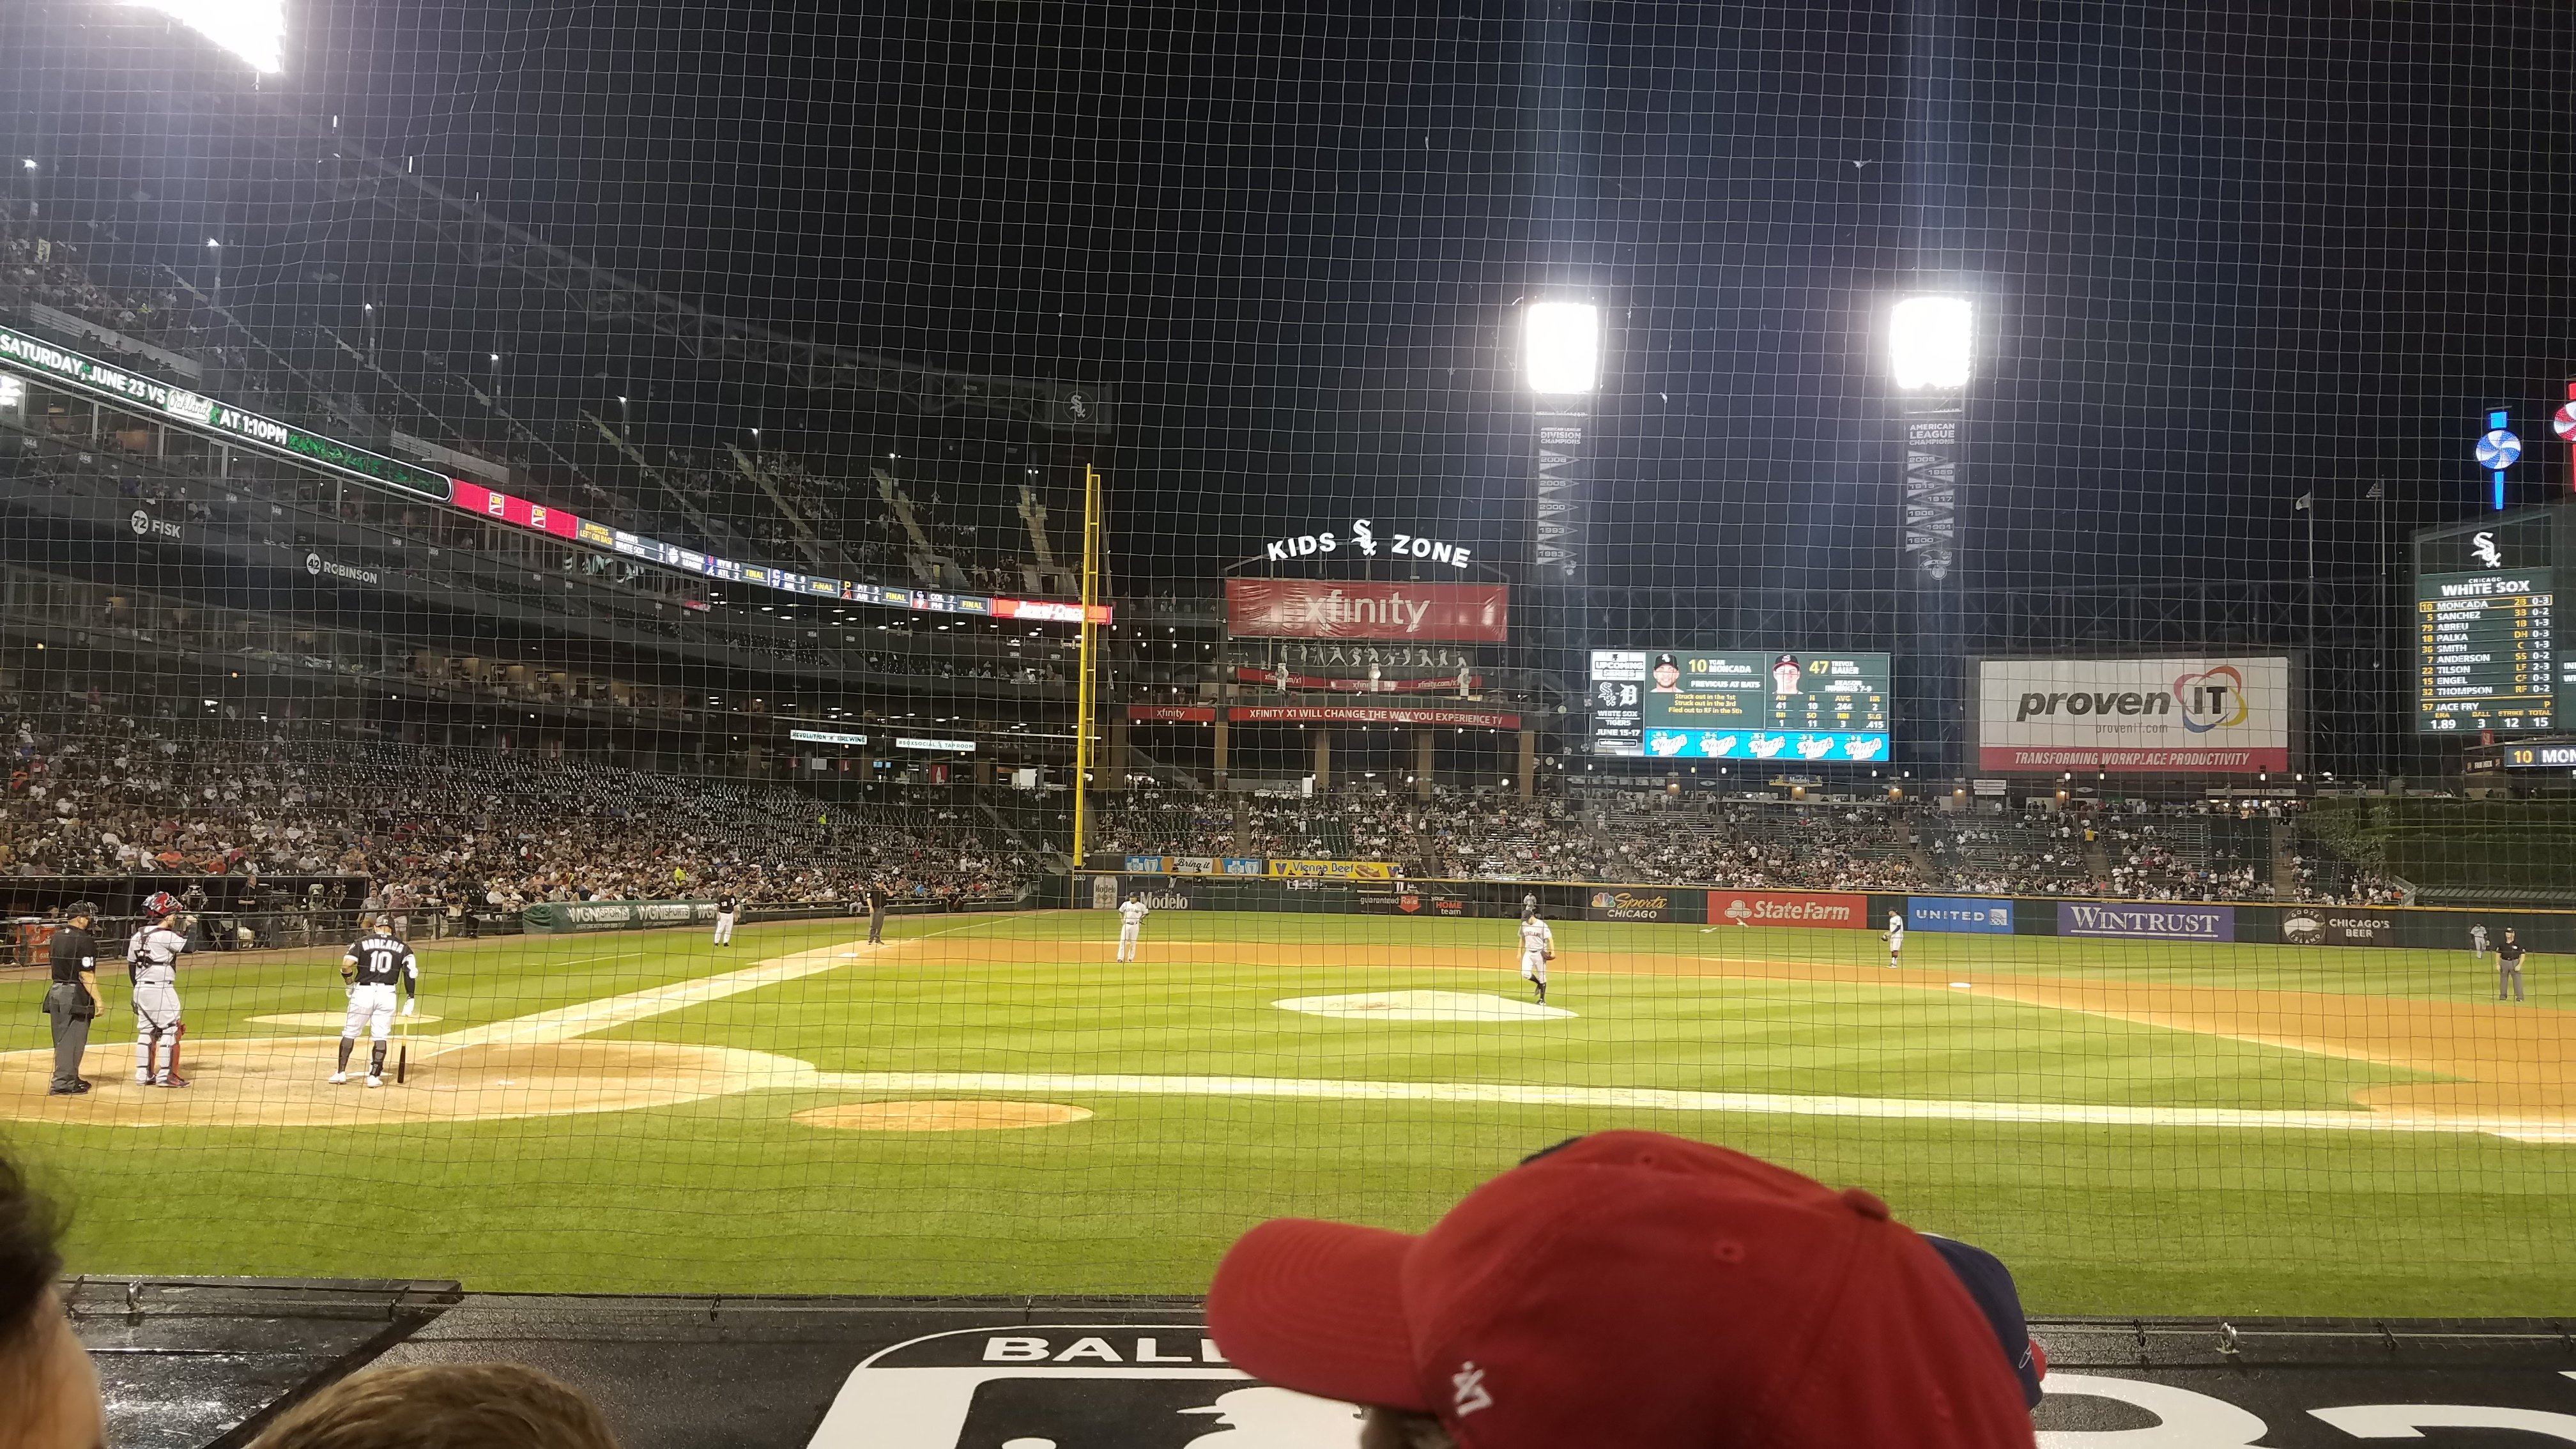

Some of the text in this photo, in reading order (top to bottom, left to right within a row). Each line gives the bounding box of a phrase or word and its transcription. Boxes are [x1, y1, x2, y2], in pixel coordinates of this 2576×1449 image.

[0, 334, 86, 380] SATURDAY,
[89, 366, 128, 391] JUNE
[128, 378, 147, 397] 23
[148, 385, 165, 404] VS
[220, 408, 241, 429] AT
[243, 416, 288, 445] 1:10PM
[1909, 423, 1955, 431] AMERICAN
[1910, 430, 1955, 440] LEAGUE
[132, 514, 181, 539] 72 FISK
[1267, 532, 1337, 562] KIDS
[1392, 534, 1471, 568] ZONE
[323, 561, 378, 585] ROBINSON
[746, 569, 765, 580] FINAL
[813, 581, 834, 592] FINAL
[2441, 580, 2530, 596] WHITE SOX
[885, 592, 907, 602] FINAL
[962, 601, 983, 609] FINAL
[2437, 601, 2488, 610] MONCADA
[1306, 590, 1431, 632] xfinity
[2437, 611, 2481, 621] SANCHEZ
[2436, 618, 2550, 631] ABREU 1-3
[2436, 633, 2469, 642] PALKA
[2436, 640, 2550, 653] SMITH 1-3
[2436, 654, 2490, 663] ANDERSON
[1689, 659, 1707, 673] 10
[1809, 661, 1830, 675] 47
[2436, 665, 2471, 674] TILSON
[2436, 676, 2468, 684] ENGEL
[2436, 686, 2493, 695] THOMPSON
[2533, 684, 2550, 693] 0-2
[2016, 686, 2228, 722] proven IT
[2421, 702, 2480, 711] 57 JACE FRY
[1156, 708, 1185, 719] xfinity
[1249, 709, 1503, 725] XFINITY X1 WILL CHANGE THE WAY YOU EXPERIENCE TV
[2430, 717, 2549, 730] 1.89 3 12 15
[2096, 723, 2168, 736] provenIT.com
[2015, 751, 2250, 766] TRANSFORMING WORKPLACE PRODUCTIVITY
[2513, 750, 2533, 763] 10
[1177, 858, 1211, 870] Bring it
[1292, 862, 1354, 873] Vienna Beef
[1095, 884, 1116, 893] Modelo
[1140, 891, 1188, 910] Modelo
[1360, 896, 1399, 905] guaranteed
[1614, 893, 1667, 911] Sports
[599, 908, 630, 919] SPORTS
[664, 907, 689, 919] SPORTS
[1607, 909, 1657, 919] CHICAGO
[1916, 908, 1985, 921] UNITED
[2291, 909, 2320, 919] GOOSE
[2070, 906, 2220, 933] WINTRUST
[2329, 918, 2391, 929] CHICAGO'S
[2290, 933, 2320, 944] ISLAND
[2345, 929, 2374, 938] BEER
[369, 950, 393, 973] 10
